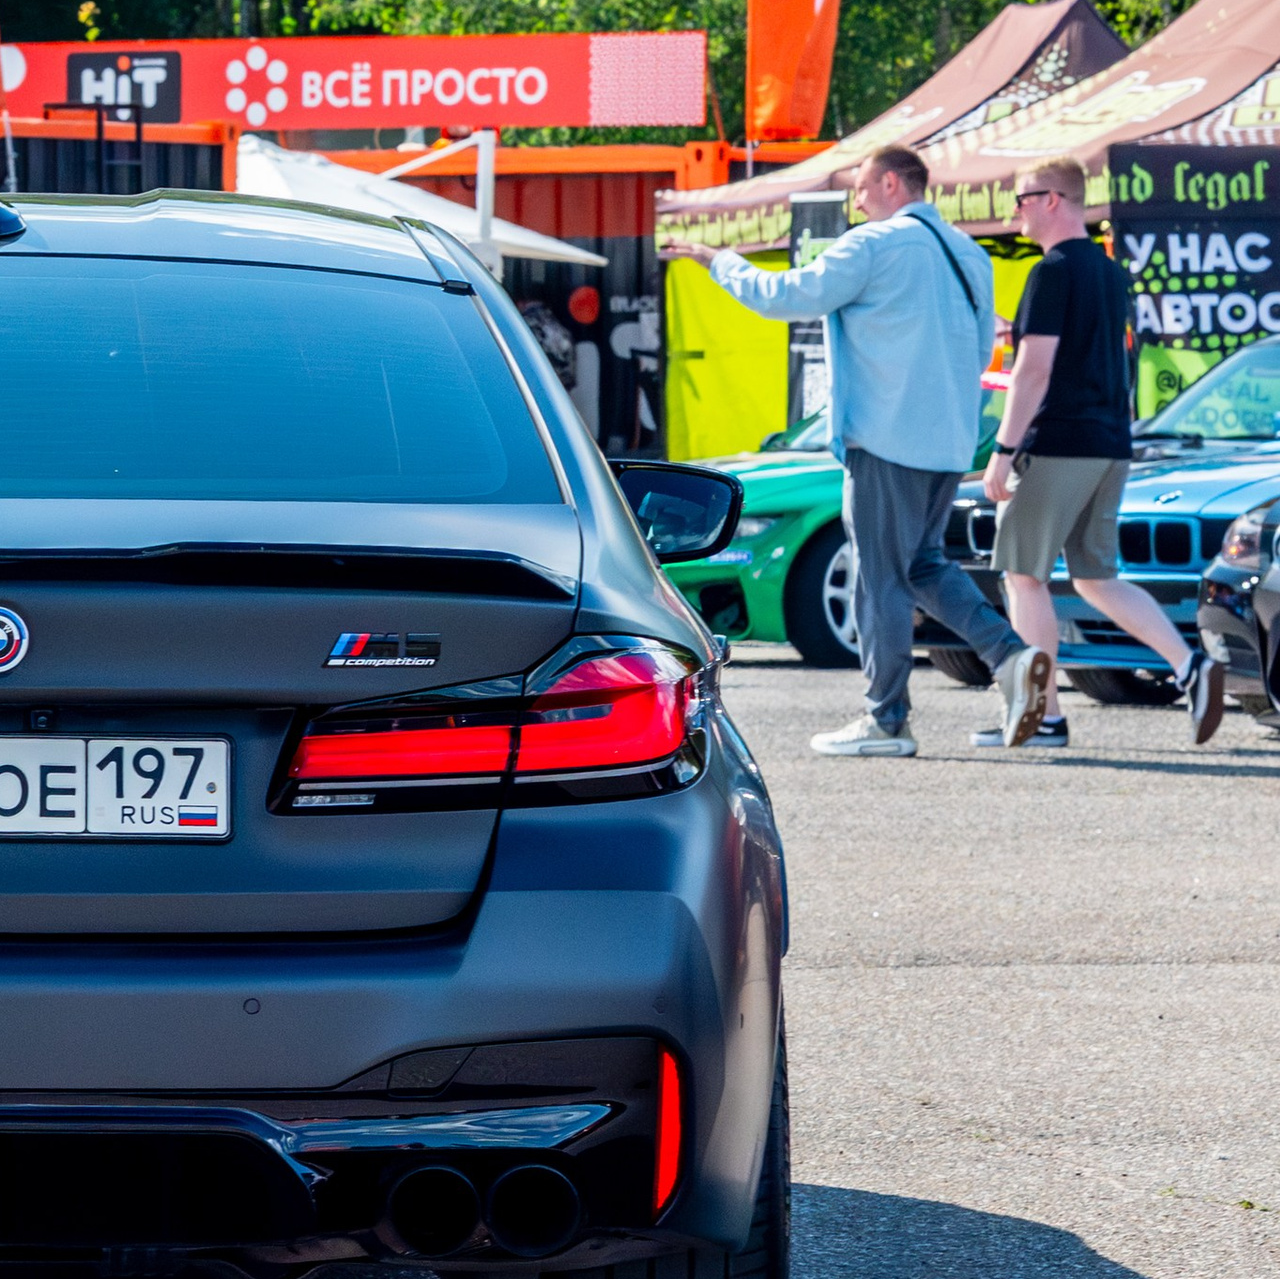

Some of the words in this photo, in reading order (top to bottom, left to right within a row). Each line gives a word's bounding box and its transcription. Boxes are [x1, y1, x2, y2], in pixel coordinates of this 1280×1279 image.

[301, 62, 372, 108] ВСЁ
[382, 66, 548, 106] ПРОСТО
[1174, 160, 1270, 210] legal
[1123, 233, 1157, 274] У
[1167, 232, 1272, 273] НАС
[345, 657, 436, 667] competition
[96, 747, 205, 800] 197
[122, 805, 175, 825] RUS
